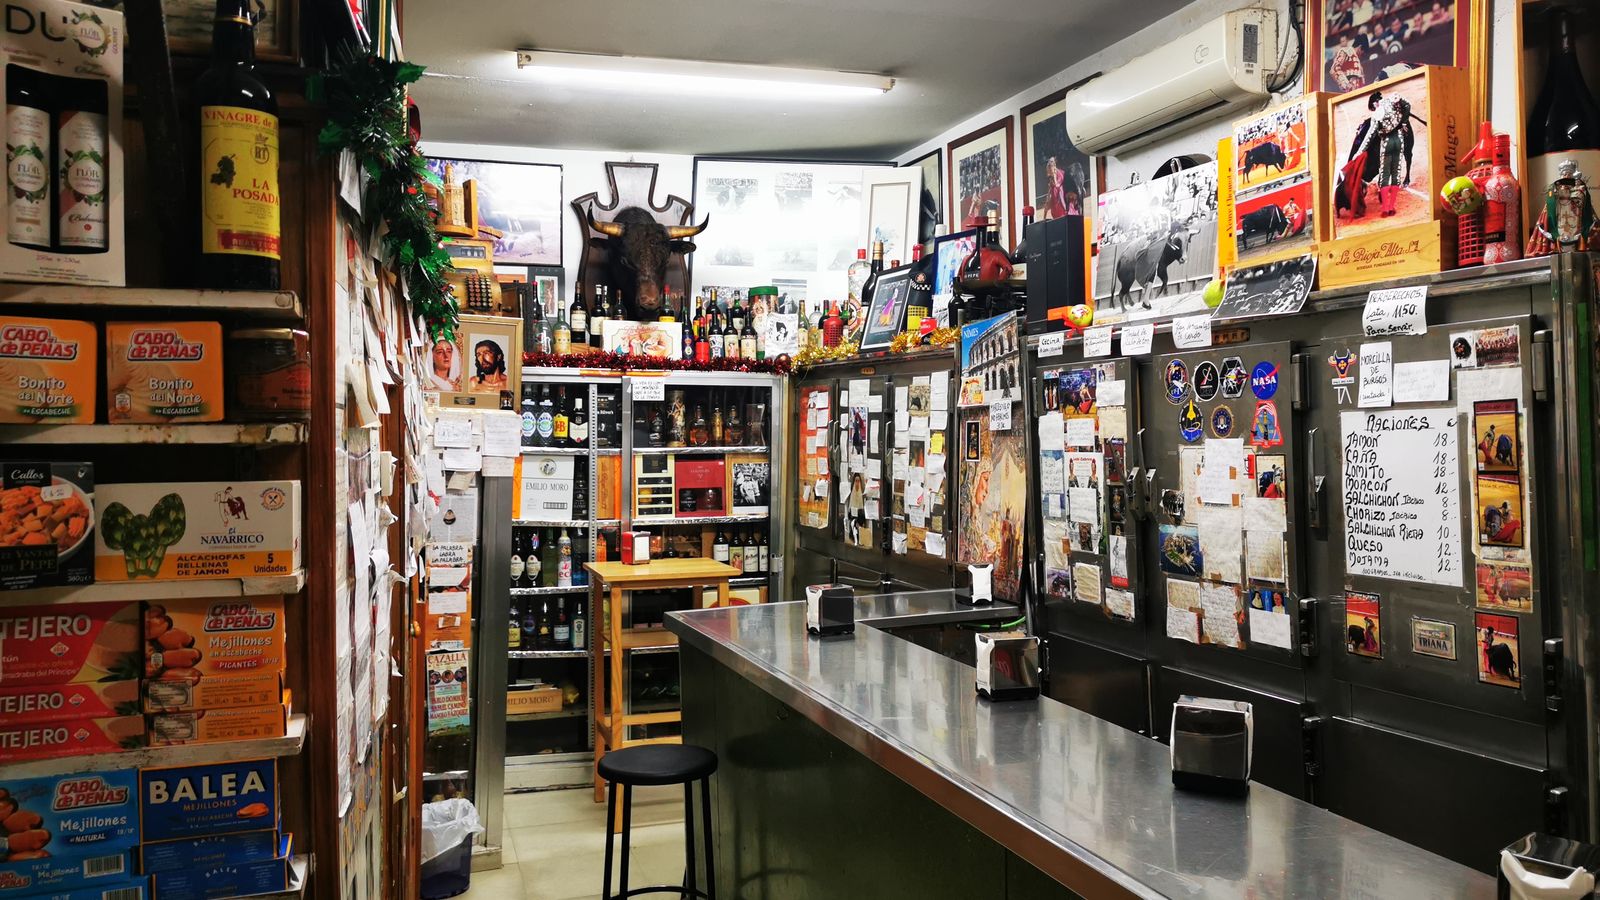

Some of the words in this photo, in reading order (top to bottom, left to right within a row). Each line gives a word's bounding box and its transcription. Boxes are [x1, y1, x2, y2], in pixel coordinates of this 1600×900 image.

[203, 109, 262, 125] VINAGRE
[1443, 114, 1460, 179] Muga
[252, 178, 270, 190] LA
[232, 187, 279, 206] POSADA
[3, 328, 49, 342] CABO
[133, 332, 175, 345] CABO
[18, 375, 66, 389] Bonito
[149, 377, 194, 390] Bonito
[1252, 376, 1277, 386] NASA
[18, 391, 34, 401] del
[37, 391, 74, 405] Norte
[166, 391, 202, 404] Norte
[11, 469, 44, 481] Callos
[525, 482, 548, 492] EMILIO
[550, 482, 569, 492] MORO
[200, 534, 265, 545] NAVARRICO
[176, 553, 246, 562] ALCACHOFAS
[267, 552, 274, 564] 5
[176, 561, 229, 570] RELLENAS
[254, 564, 287, 573] Unidades
[212, 603, 249, 616] CABO
[209, 635, 273, 649] Mejillones
[1419, 637, 1449, 652] TRIANA
[219, 659, 258, 669] PICANTES
[60, 779, 101, 795] CABO
[149, 770, 266, 805] BALEA
[183, 798, 238, 812] MEJILLONES
[60, 815, 128, 832] Mejillones
[75, 833, 106, 843] NATURAL
